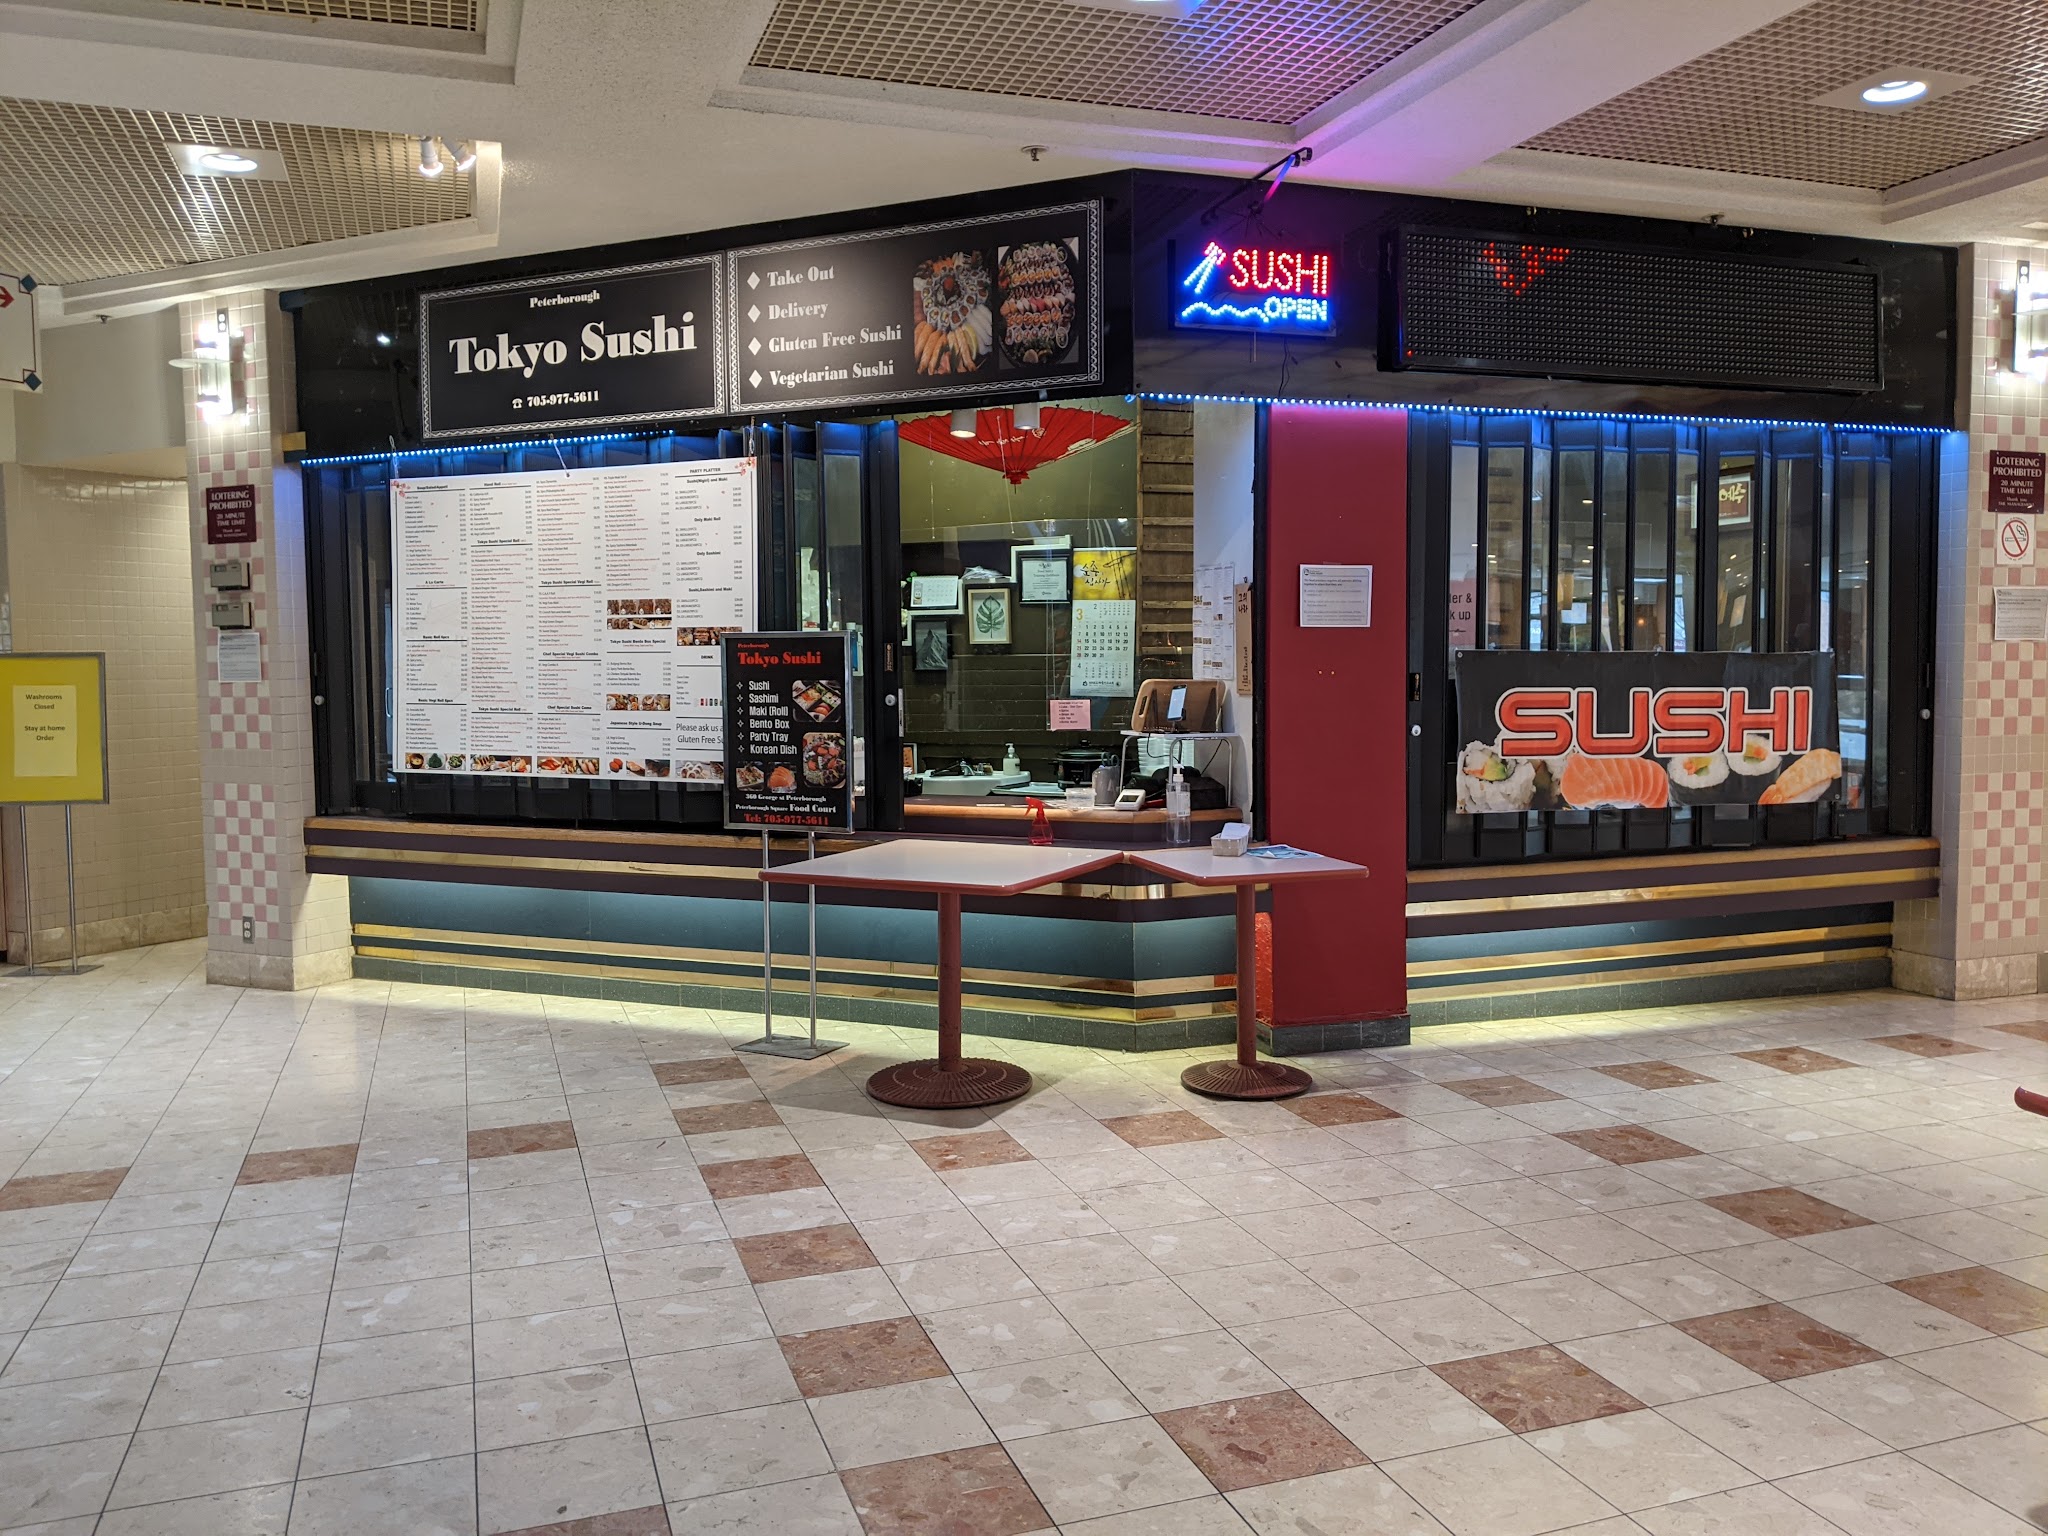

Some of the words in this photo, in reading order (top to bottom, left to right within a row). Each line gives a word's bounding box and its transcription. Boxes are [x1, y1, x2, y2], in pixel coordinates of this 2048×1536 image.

[767, 270, 804, 287] Take
[807, 265, 835, 282] Out
[1229, 249, 1328, 295] SUSHI
[529, 289, 601, 308] Peterborough
[768, 302, 828, 320] Delivery
[1264, 296, 1328, 321] OPEN
[768, 336, 817, 353] Gluten
[822, 332, 856, 348] Free
[860, 324, 902, 344] Sushi
[449, 333, 568, 379] Tokyo
[581, 311, 697, 362] Sushi
[769, 366, 848, 389] Vegetarian
[852, 359, 894, 379] Sushi
[527, 390, 600, 407] 705-977-5611
[1996, 456, 2040, 467] LOITERING
[1993, 467, 2043, 478] PROHIBITED
[2010, 480, 2034, 488] MINUTE
[211, 490, 250, 501] LOITERING
[209, 500, 253, 511] PROHIBITED
[1466, 593, 1472, 603] &
[1076, 608, 1083, 621] 3
[1459, 611, 1471, 621] up
[738, 652, 779, 668] Tokyo
[782, 651, 821, 664] Sushi
[749, 680, 770, 691] Sushi
[749, 693, 779, 703] Sashimi
[749, 706, 767, 716] Maki
[769, 706, 789, 717] (Roll)
[676, 723, 697, 731] Please
[698, 723, 710, 731] ask
[750, 719, 773, 729] Bento
[774, 719, 790, 729] Box
[1495, 686, 1813, 759] SUSHI
[677, 735, 700, 743] Gluten
[701, 735, 716, 744] Free
[750, 731, 770, 742] Party
[771, 731, 789, 743] Tray
[750, 744, 778, 754] Korean
[779, 744, 797, 755] Dish
[789, 803, 810, 812] Food
[812, 804, 836, 813] Court
[744, 813, 761, 822] Tel:
[763, 814, 829, 825] 705-977-5611
